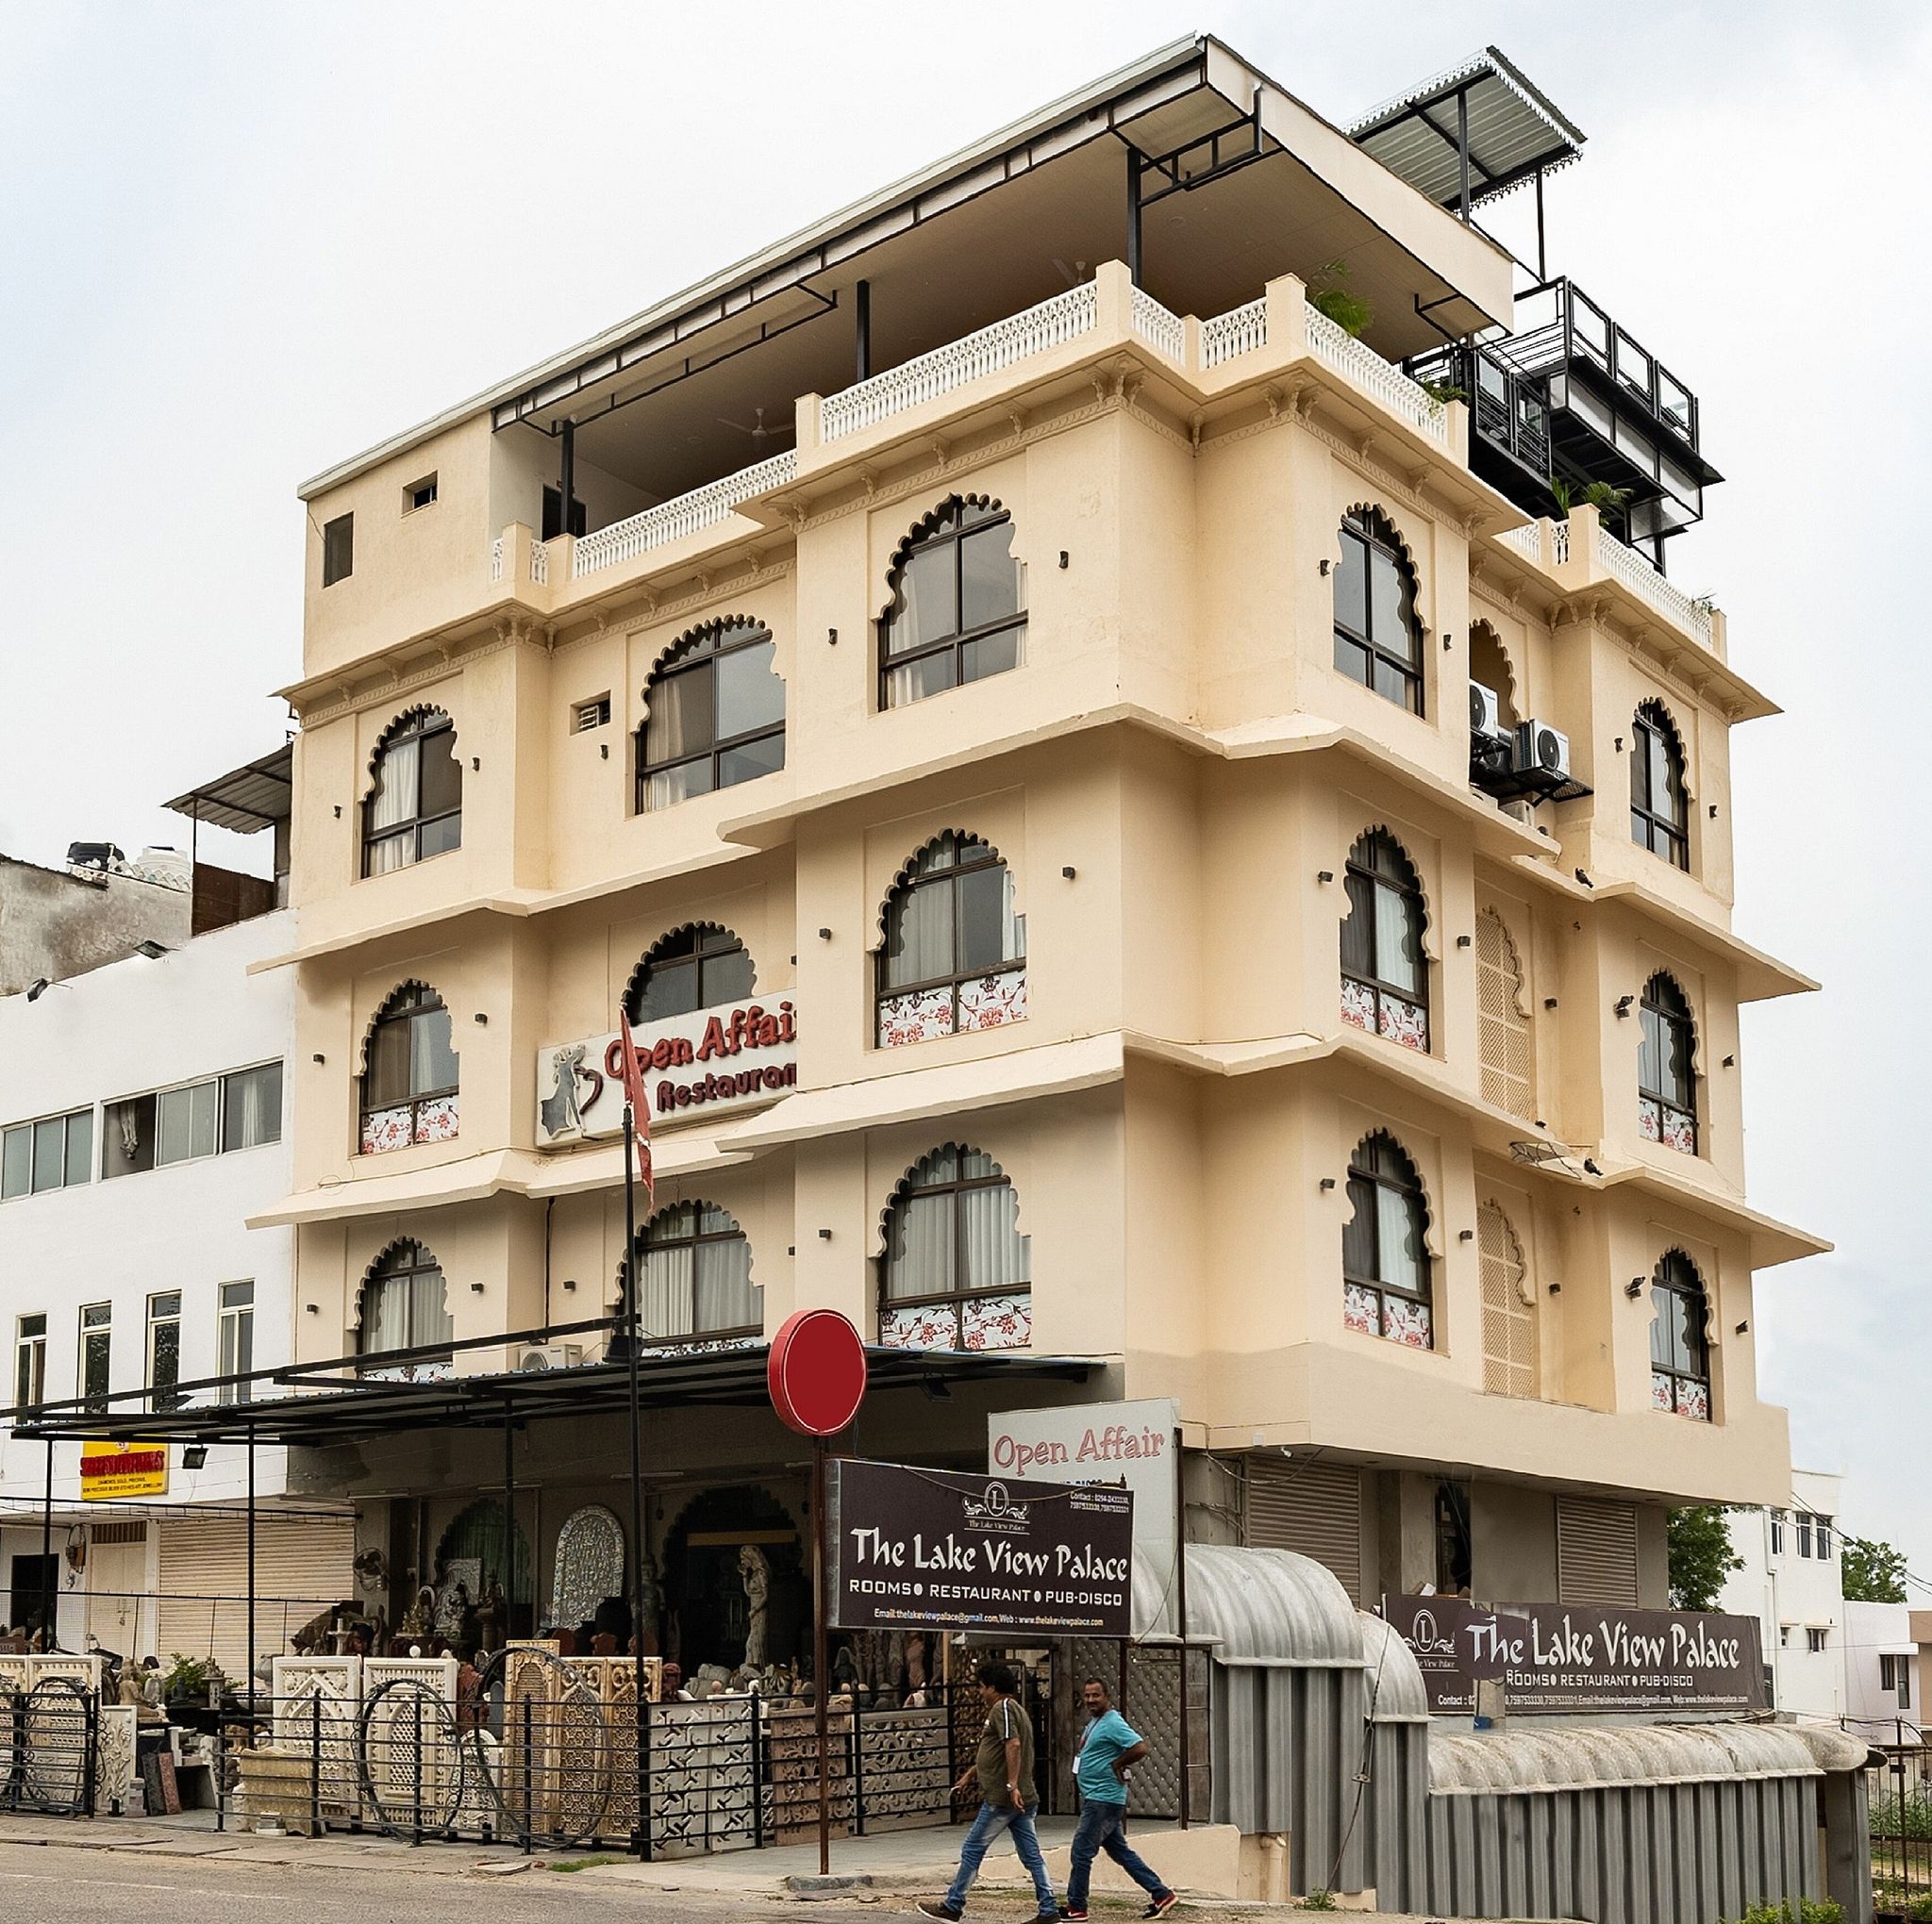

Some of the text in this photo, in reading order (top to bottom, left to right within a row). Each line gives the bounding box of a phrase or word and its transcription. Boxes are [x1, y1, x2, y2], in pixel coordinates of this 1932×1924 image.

[696, 1001, 797, 1062] Affai
[657, 1063, 797, 1114] Restauran
[993, 1425, 1165, 1477] Open Affair
[969, 1519, 979, 1528] The
[980, 1520, 993, 1529] Lake
[994, 1521, 1008, 1530] View
[850, 1527, 1128, 1583] The Lake View Palace
[850, 1579, 1123, 1607] ROOMS RESTAURANT PUB-DISCO
[1465, 1615, 1740, 1669] The Lake View Palace
[1438, 1694, 1463, 1705] Contact
[1506, 1670, 1693, 1687] ROOMS RESTAURANT PUB-DISCO
